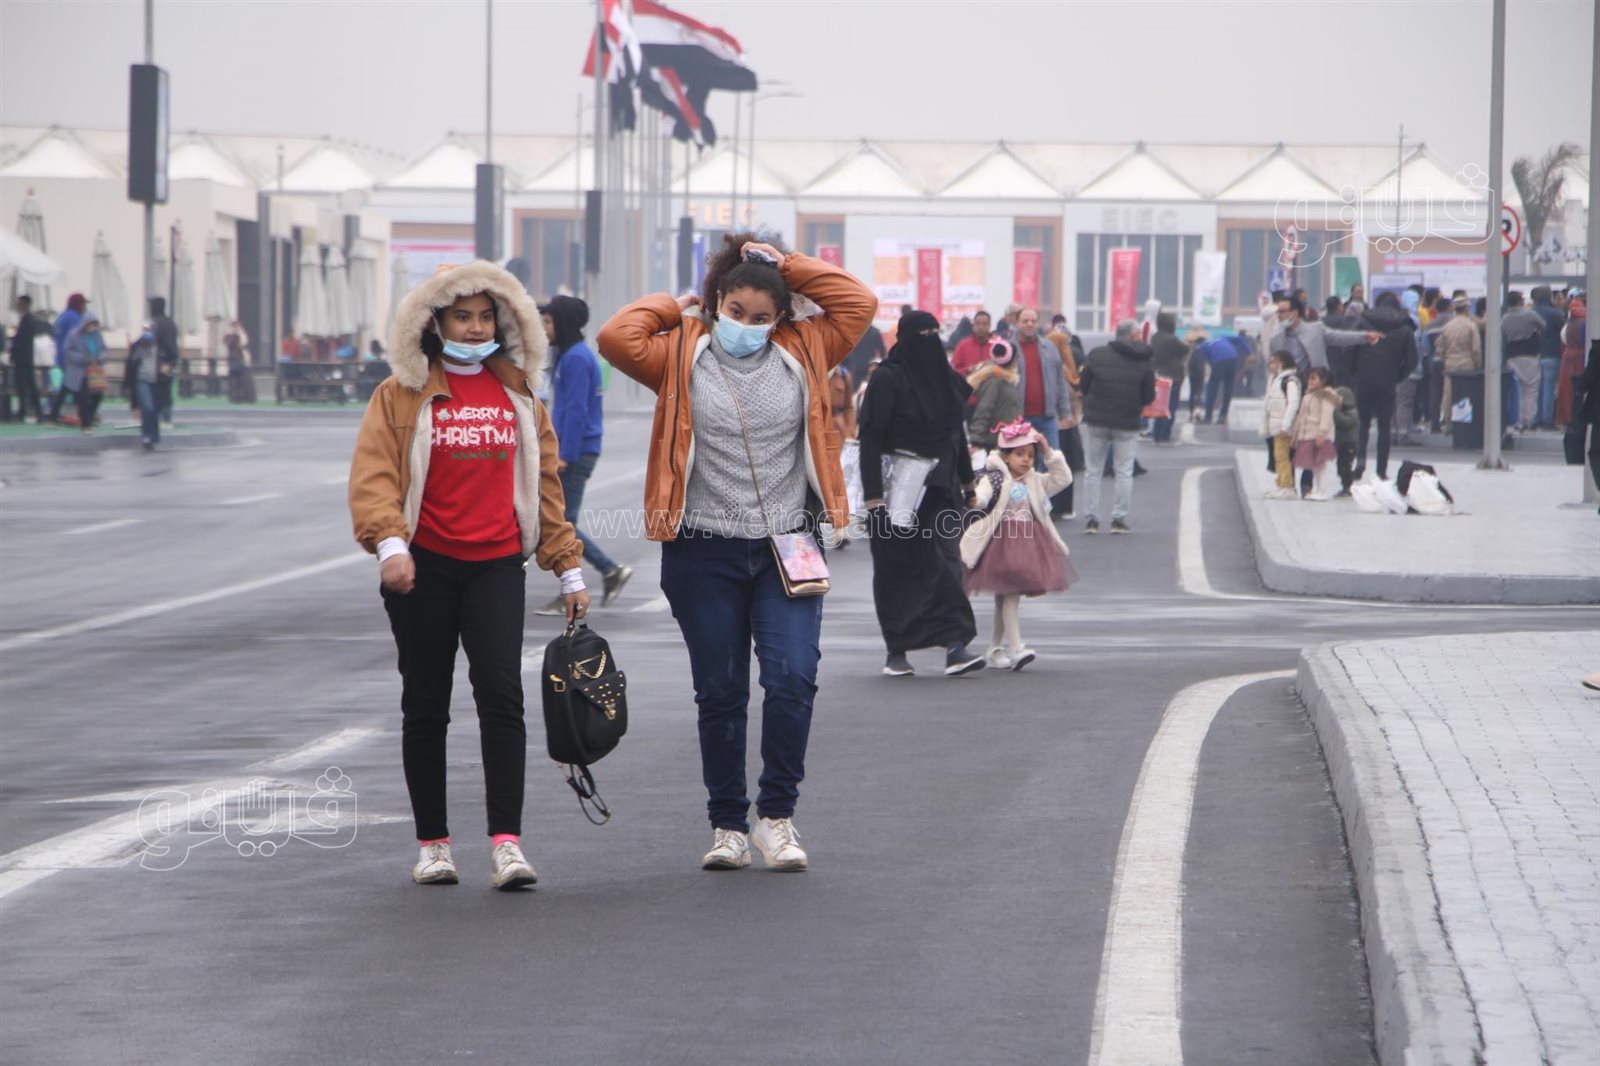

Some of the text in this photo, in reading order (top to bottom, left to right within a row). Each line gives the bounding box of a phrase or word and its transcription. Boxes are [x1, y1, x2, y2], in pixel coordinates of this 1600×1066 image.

[1102, 207, 1179, 231] EIEC
[452, 406, 500, 420] MERRY
[431, 424, 517, 446] HRISTMA
